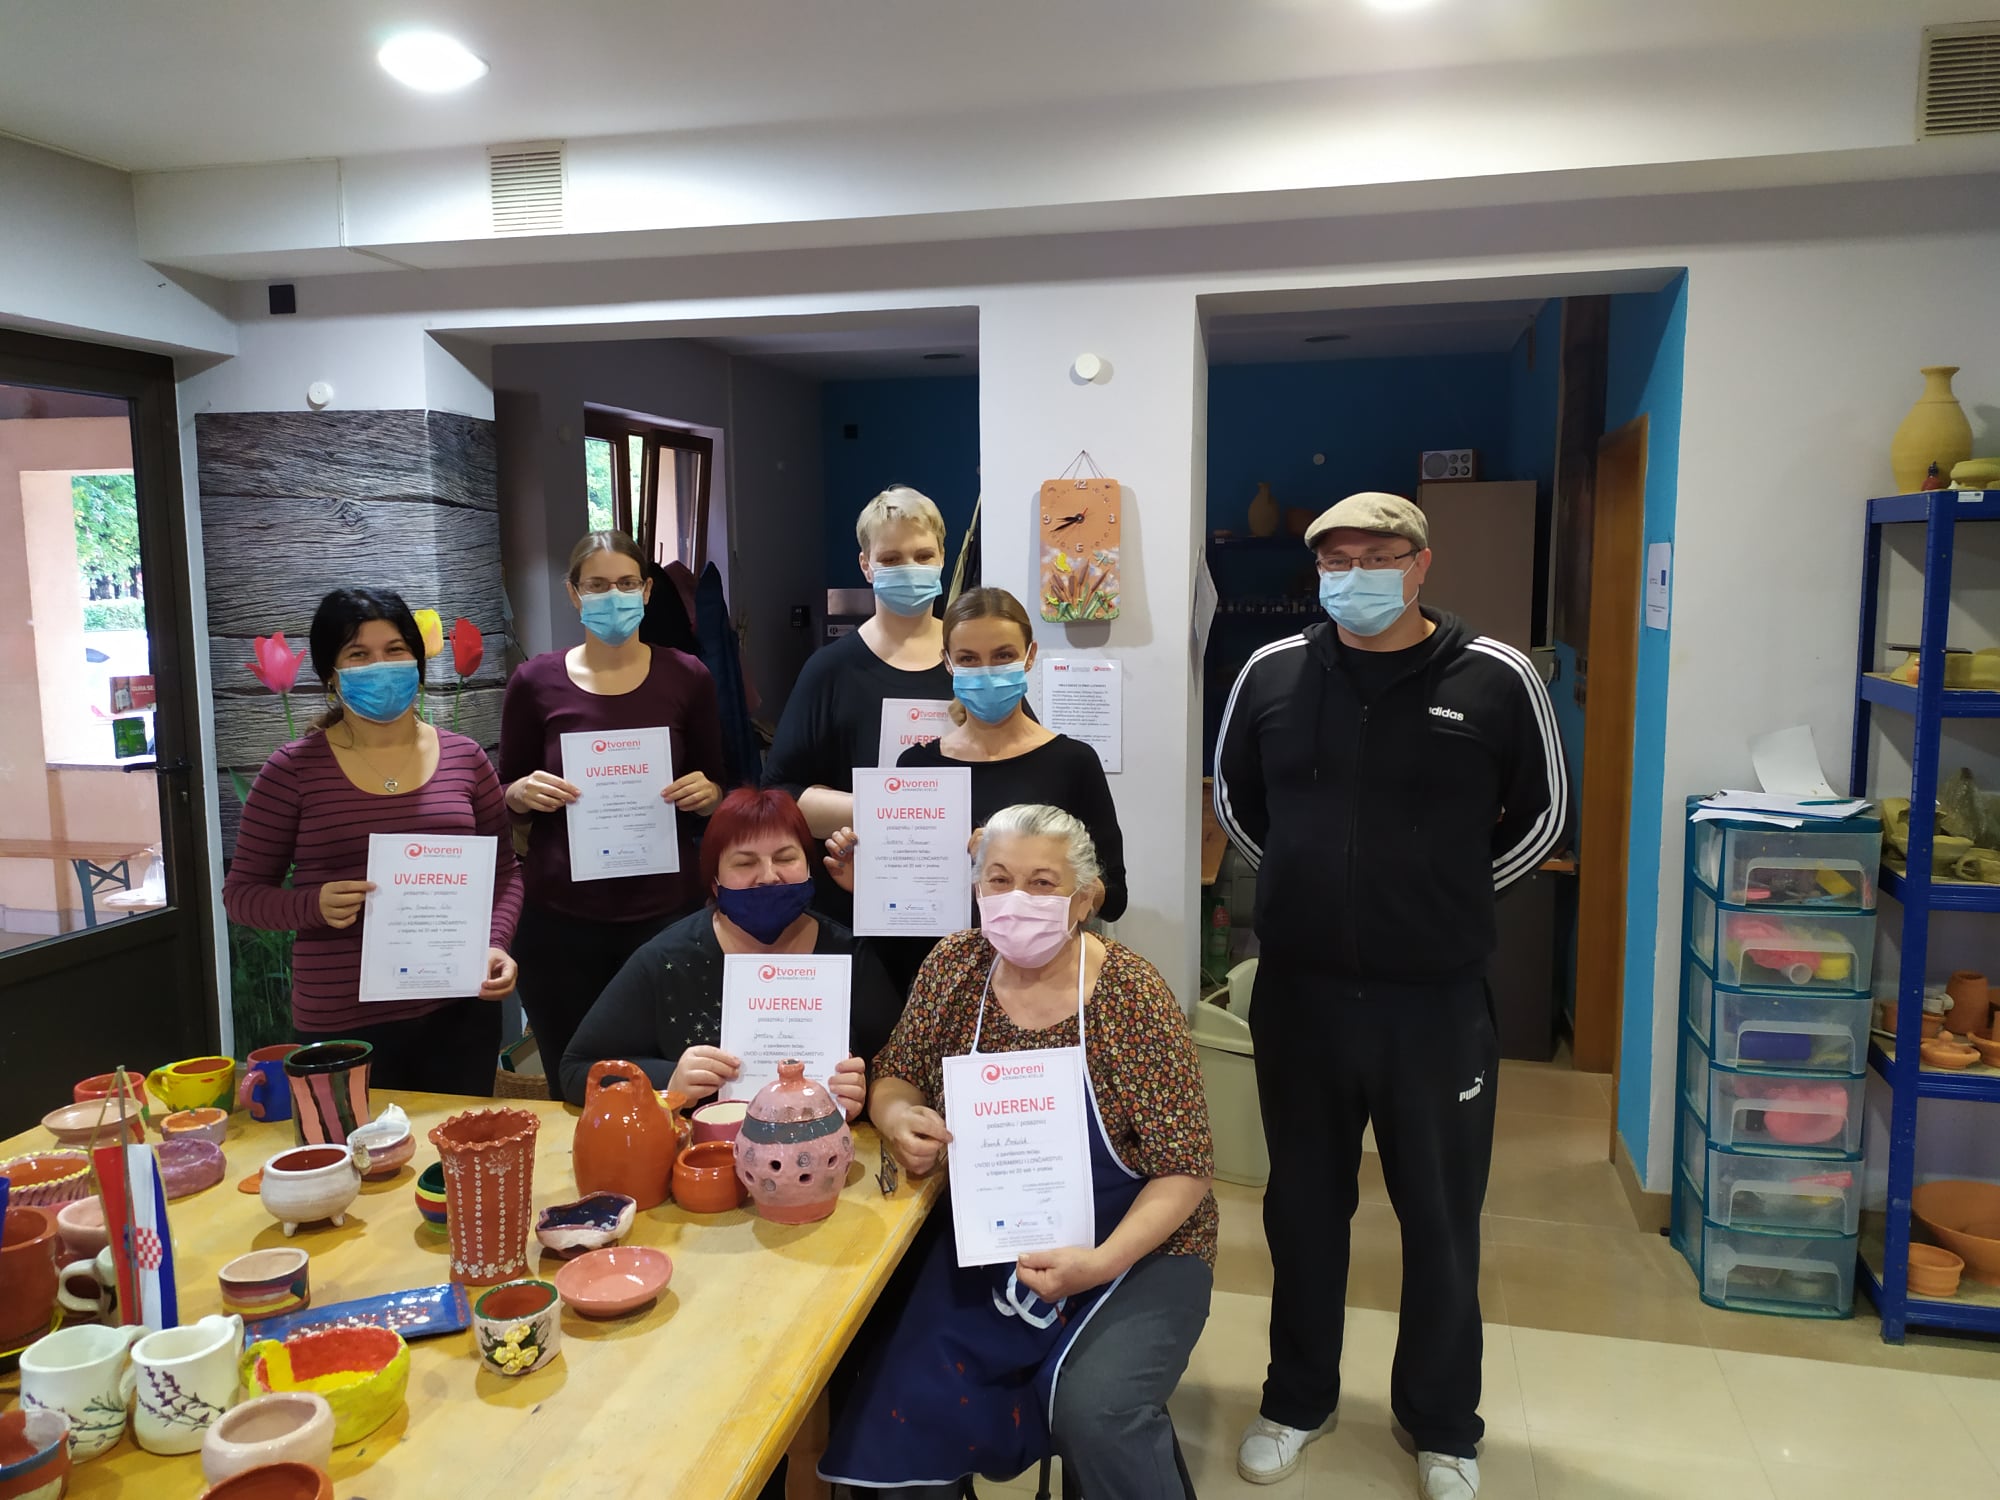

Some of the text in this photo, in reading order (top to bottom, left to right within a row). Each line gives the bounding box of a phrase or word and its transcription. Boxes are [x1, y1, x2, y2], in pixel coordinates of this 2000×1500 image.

[1074, 479, 1088, 490] 12
[586, 763, 649, 778] UVJERENJE
[877, 807, 945, 820] UVJERENJE
[394, 873, 468, 886] UVJERENJE
[748, 998, 823, 1010] UVJERENJE
[974, 1096, 1056, 1117] UVJERENJE
